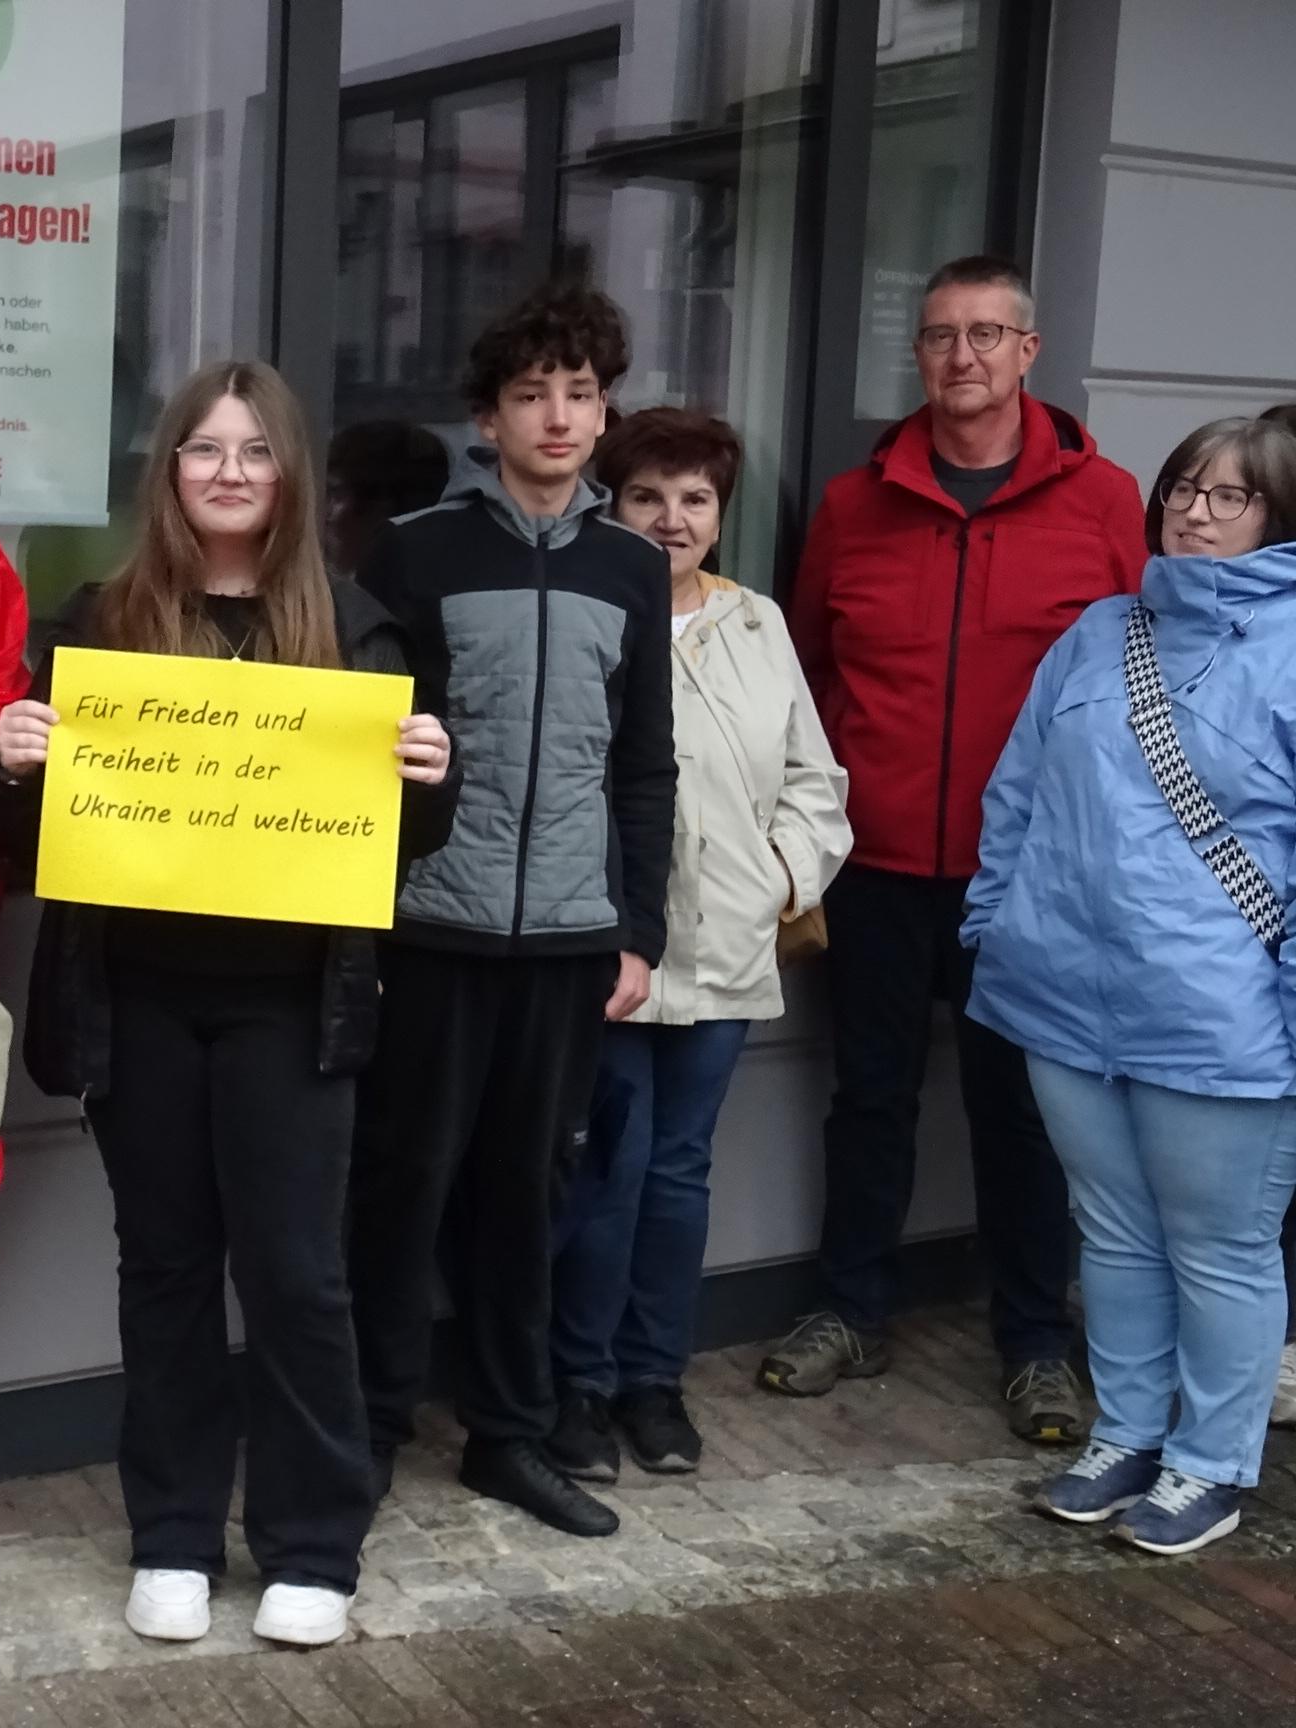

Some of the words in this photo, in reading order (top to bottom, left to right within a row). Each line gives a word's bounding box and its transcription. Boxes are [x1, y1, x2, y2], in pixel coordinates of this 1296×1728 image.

[9, 296, 43, 308] oder
[75, 695, 123, 719] Für
[137, 698, 239, 728] Frieden
[255, 707, 307, 732] und
[72, 745, 181, 773] Freiheit
[195, 754, 220, 777] in
[235, 754, 281, 780] der
[69, 793, 172, 824] Ukraine
[188, 804, 240, 828] und
[254, 808, 375, 838] weltweit
